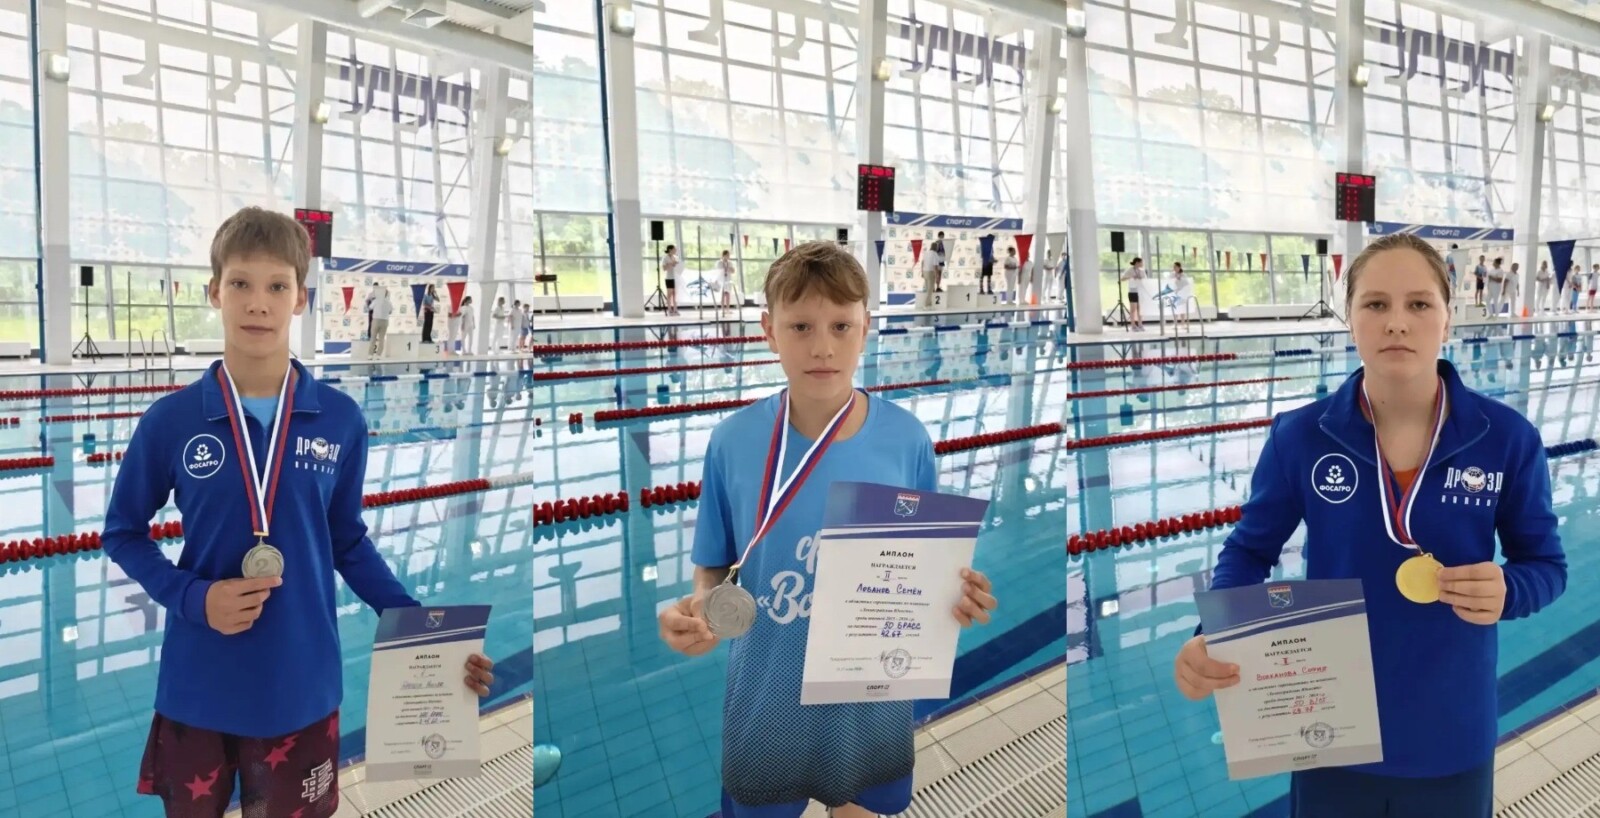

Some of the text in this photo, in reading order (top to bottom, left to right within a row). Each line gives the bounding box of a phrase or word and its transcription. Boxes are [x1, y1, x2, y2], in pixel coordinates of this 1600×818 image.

[1432, 228, 1453, 236] СПОРТ
[188, 459, 219, 470] ФОСАГРО
[1444, 466, 1504, 493] ДРОЗД
[1319, 484, 1351, 493] ФОСАГРО
[880, 550, 914, 558] ДИПЛОМ
[254, 558, 269, 575] 2
[871, 562, 916, 570] НАГРАЖДАЕТСЯ
[1270, 637, 1307, 647] ДИПЛОМ
[1264, 647, 1312, 657] НАГРАЖДАЕТСЯ
